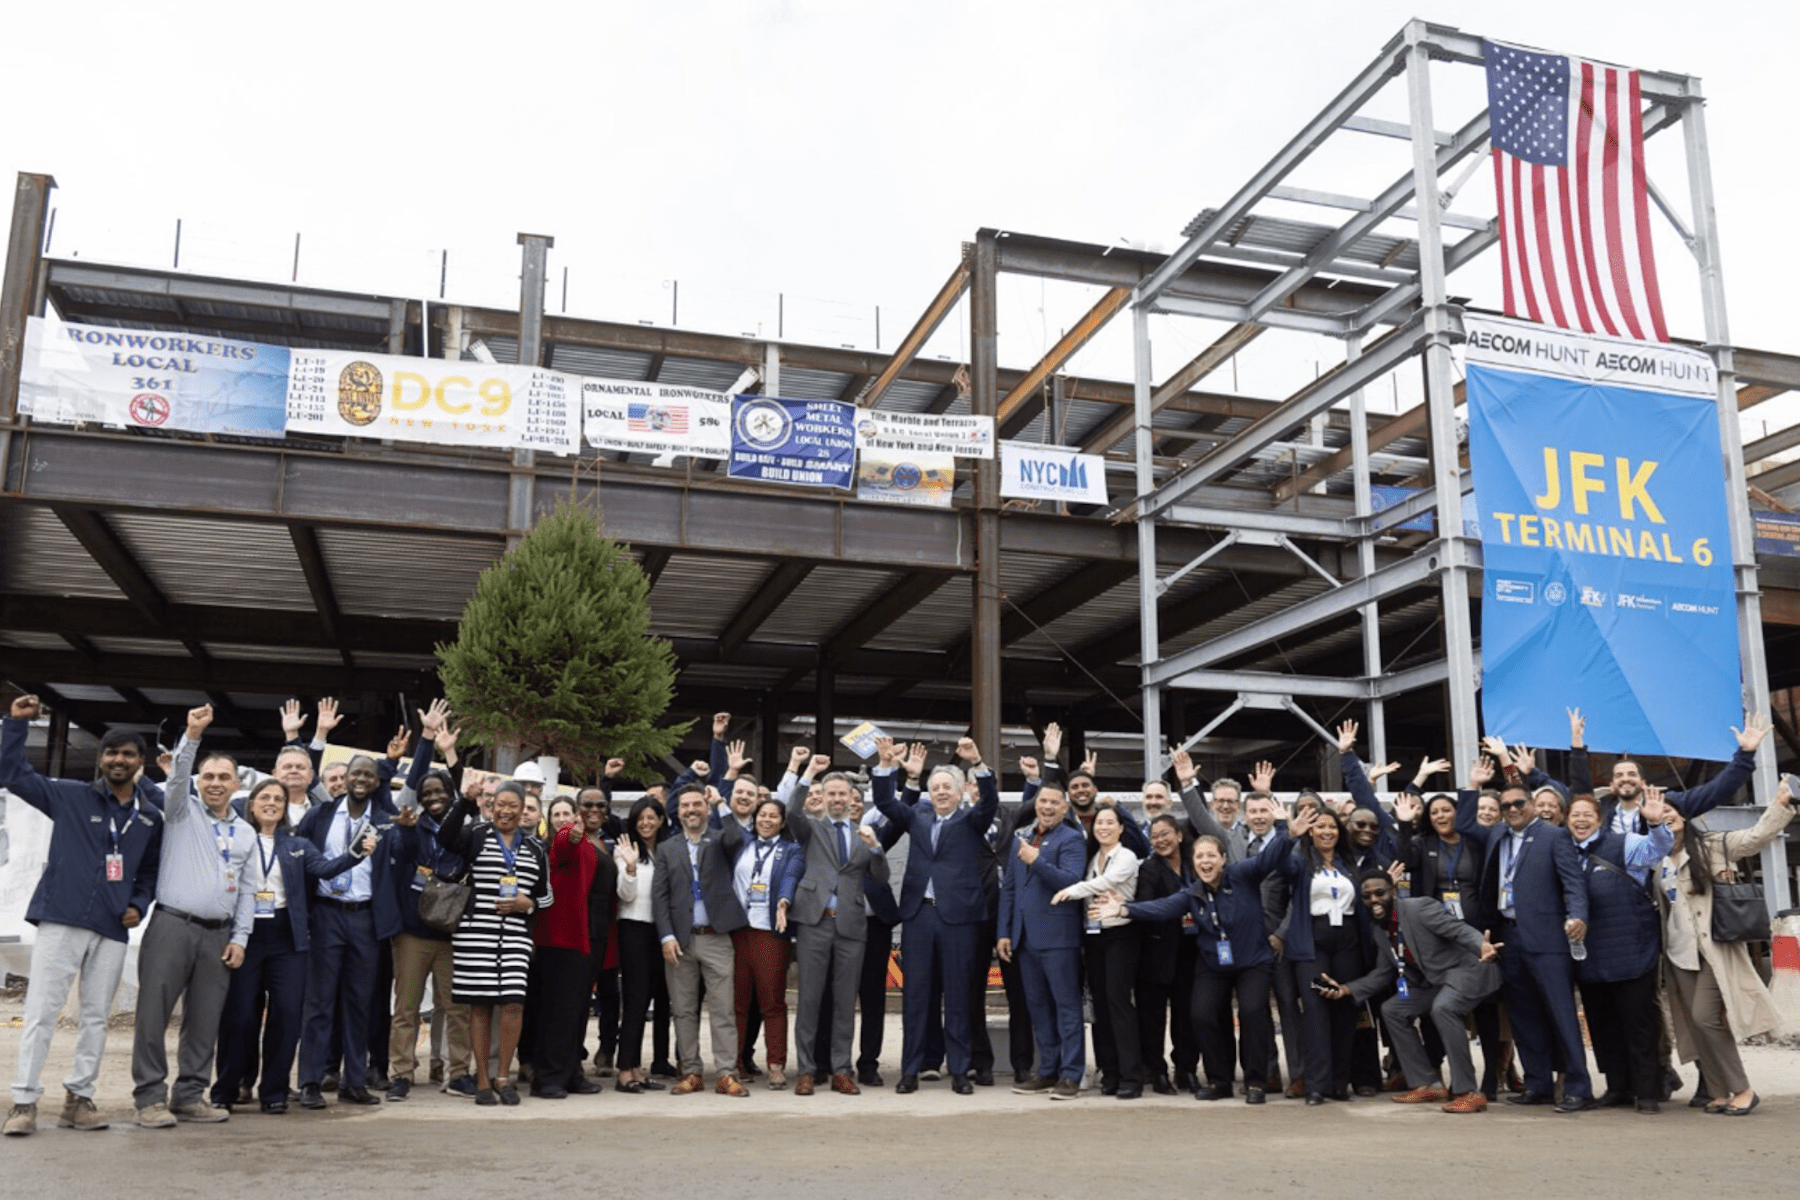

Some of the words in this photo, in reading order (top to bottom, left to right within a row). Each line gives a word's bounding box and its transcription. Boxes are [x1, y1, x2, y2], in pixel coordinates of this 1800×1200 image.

[67, 327, 257, 360] RONWORKERS
[113, 352, 198, 374] LOCAL
[1467, 330, 1531, 356] AECOM
[1535, 342, 1590, 366] HUNT
[1596, 352, 1656, 375] AECOM
[1660, 360, 1711, 382] HUNT
[131, 377, 174, 390] 361
[391, 370, 512, 417] DC9
[584, 383, 652, 396] ORNAMENTAL
[659, 388, 730, 404] IRONWORKERS
[587, 409, 625, 420] LOCAL
[806, 402, 842, 413] SHEET
[388, 416, 434, 428] NEW
[450, 421, 506, 432] YORK
[805, 411, 843, 424] METAL
[891, 414, 921, 425] Marble
[923, 417, 939, 427] and
[942, 418, 977, 428] Terrazzo
[794, 422, 853, 437] WORKERS
[672, 444, 688, 452] BUILT
[705, 447, 729, 455] QUALITY
[795, 435, 822, 446] LOCAL
[825, 437, 852, 449] UNION
[866, 438, 874, 447] of
[876, 439, 894, 449] New
[896, 440, 914, 450] York
[917, 443, 933, 451] and
[935, 443, 953, 453] New
[955, 444, 983, 455] Jersey
[761, 466, 790, 480] BUILD
[791, 469, 823, 483] UNION
[1020, 458, 1057, 485] NYC
[1536, 446, 1666, 524] JFK
[1492, 511, 1683, 564] TERMINAL
[1692, 537, 1714, 567] 6
[1617, 594, 1636, 608] JFK
